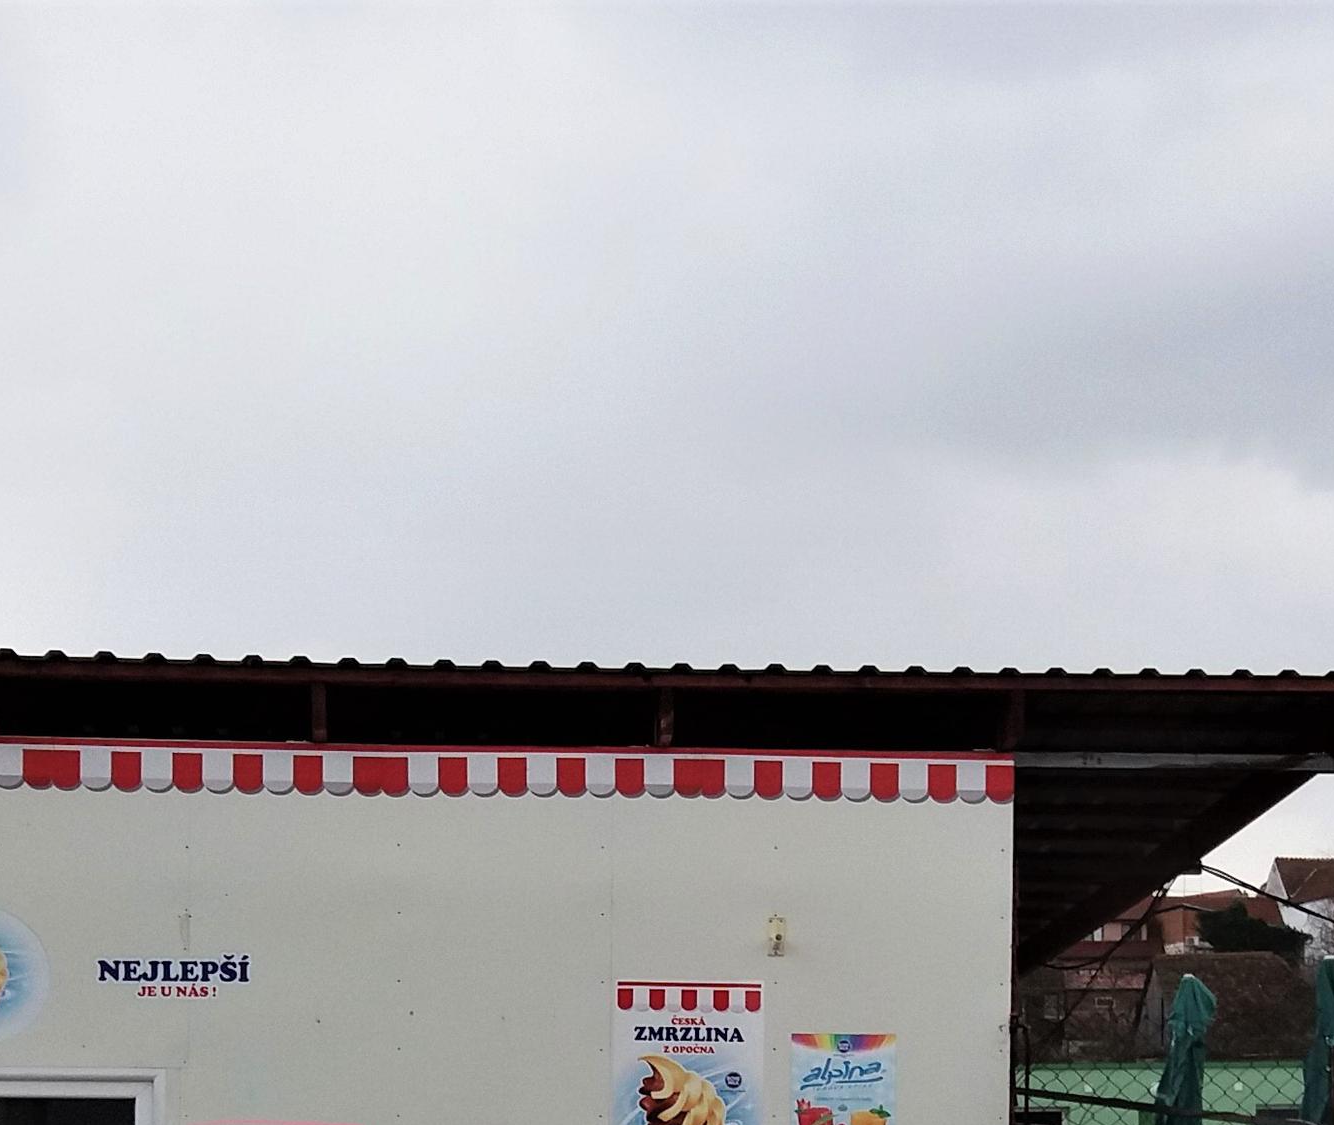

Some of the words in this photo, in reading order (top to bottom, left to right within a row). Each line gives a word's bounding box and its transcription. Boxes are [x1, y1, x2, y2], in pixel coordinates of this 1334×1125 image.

[97, 954, 250, 982] NEJLEPŠÍ
[137, 986, 157, 997] JE
[160, 986, 173, 997] U
[671, 1015, 706, 1026] ČESKÁ
[634, 1026, 744, 1043] ZMRZLINA
[672, 1044, 715, 1054] OPOČNA
[802, 1058, 882, 1085] alpina
